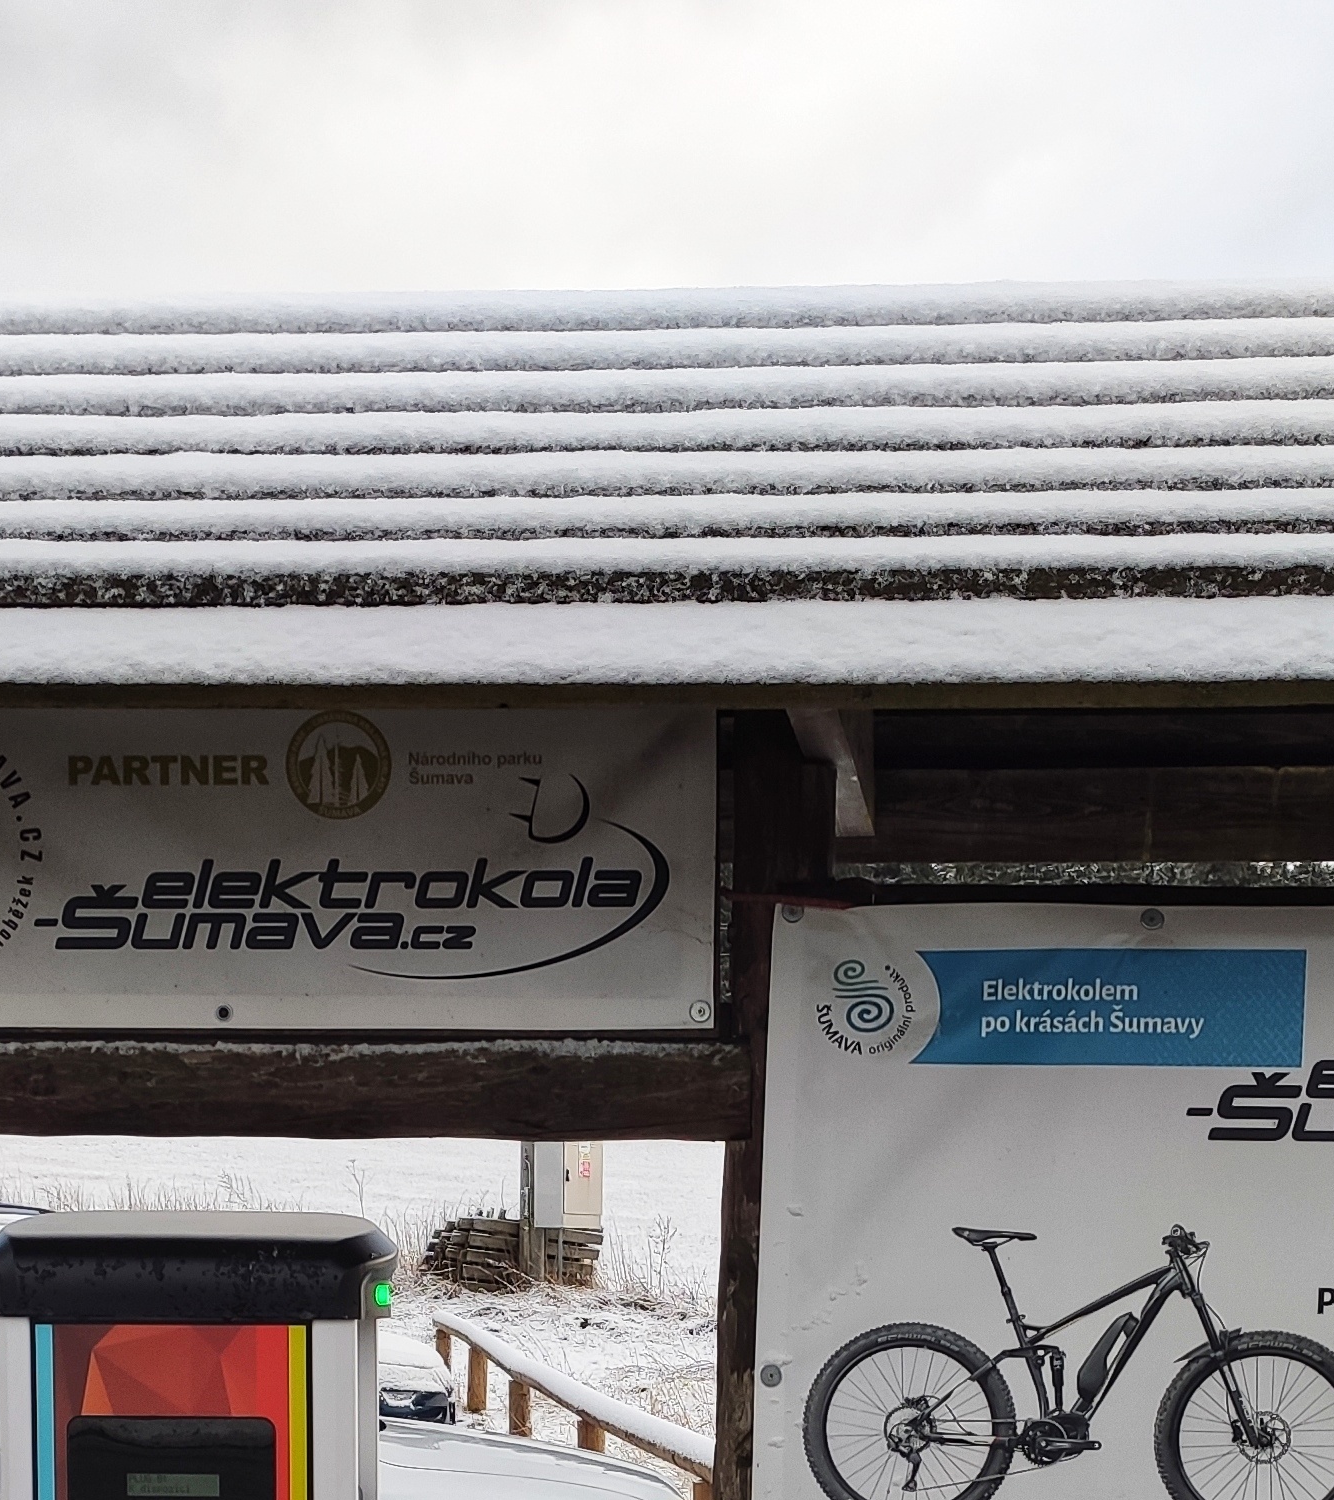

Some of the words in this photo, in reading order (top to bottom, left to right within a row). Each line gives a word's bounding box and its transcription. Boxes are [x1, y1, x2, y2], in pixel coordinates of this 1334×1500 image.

[67, 754, 270, 787] PARTNER
[497, 753, 543, 768] parku
[409, 770, 474, 785] Šumava
[142, 857, 643, 911] elektrokola
[983, 977, 1138, 1001] Elektrokolem
[816, 1003, 863, 1055] ŠUMAVA
[869, 1014, 913, 1055] originální
[981, 1016, 1010, 1038] po
[1015, 1009, 1104, 1033] krásách
[1109, 1004, 1205, 1039] Šumavy
